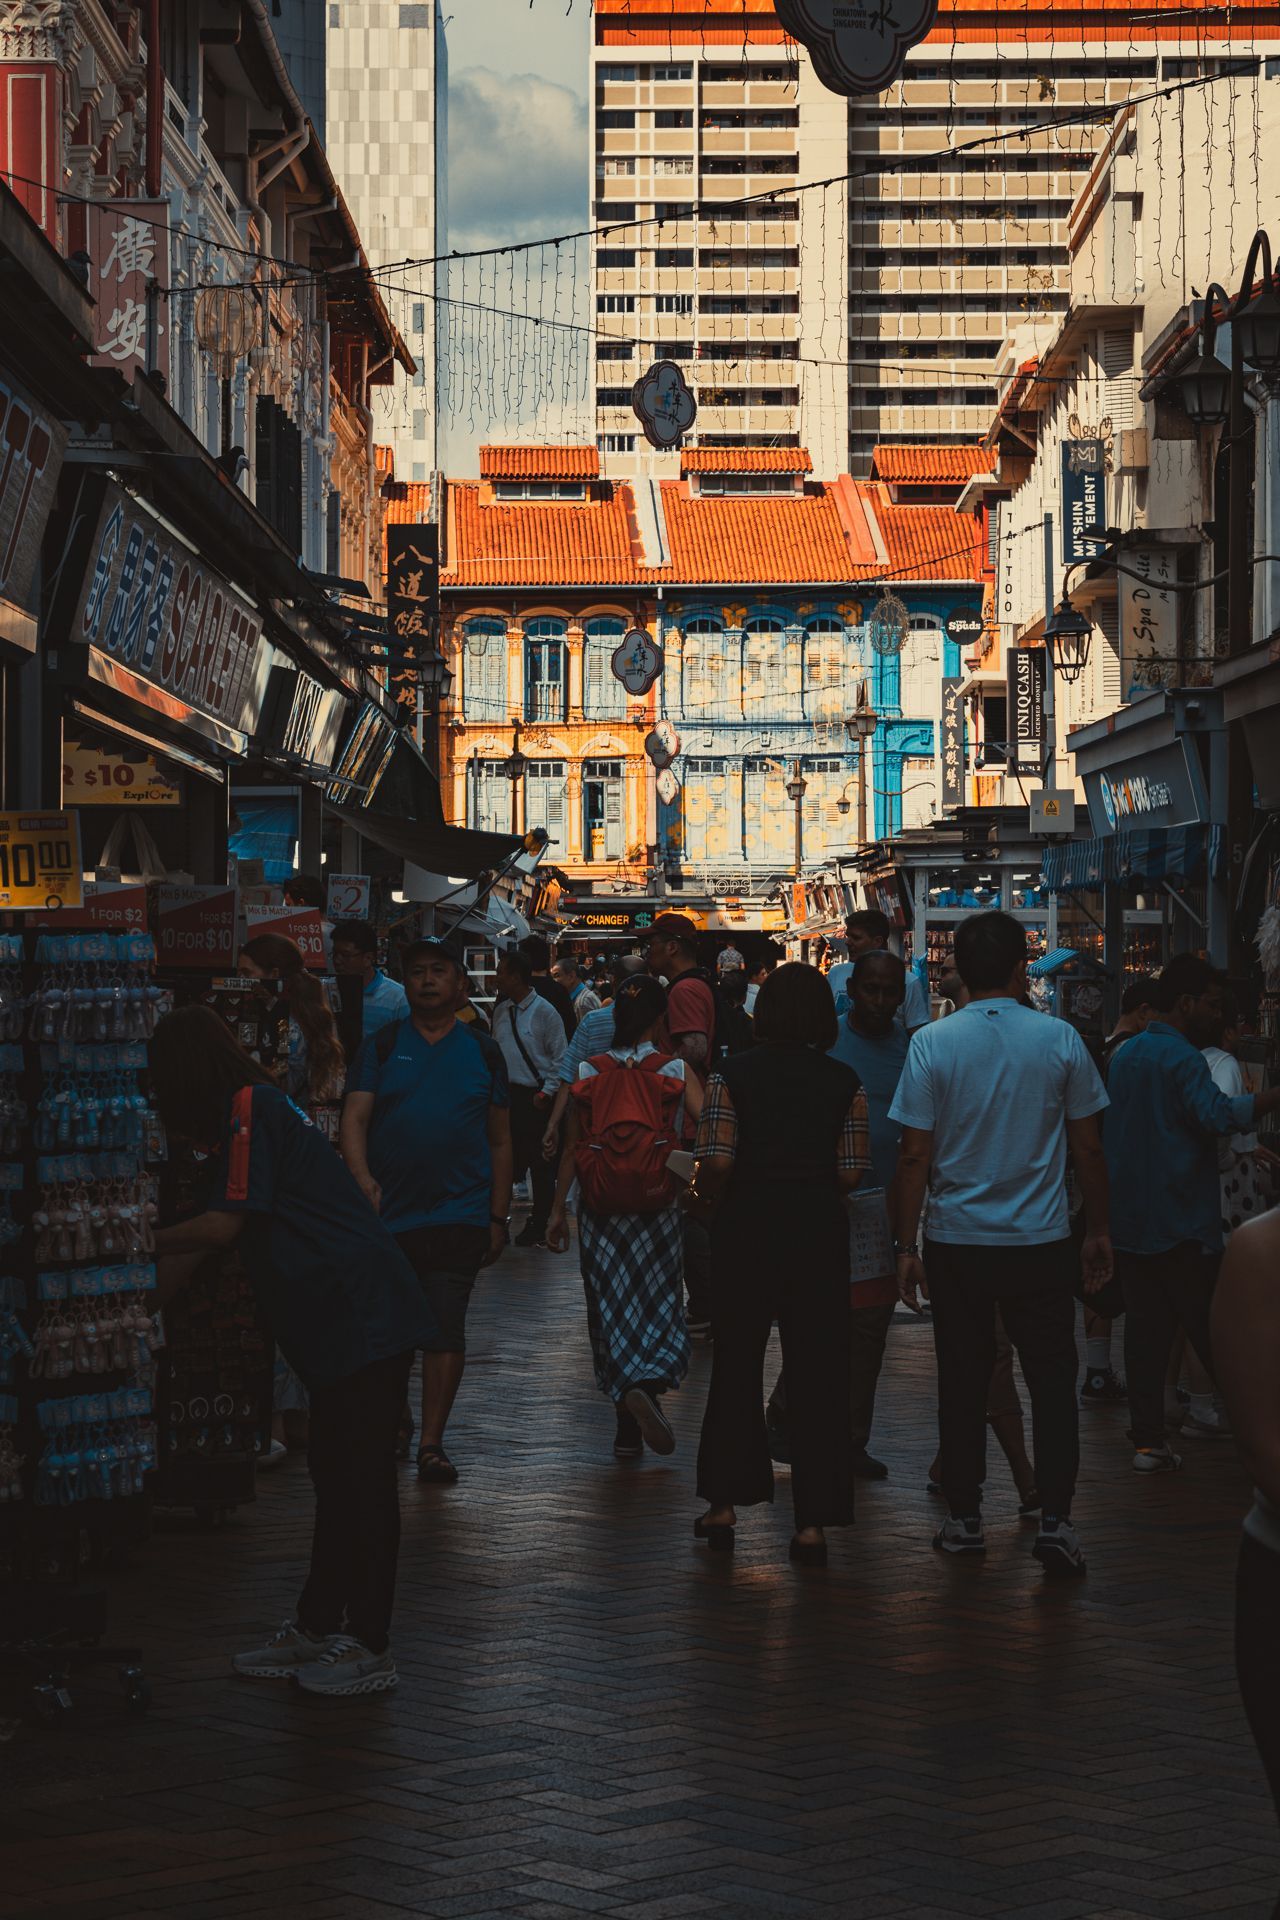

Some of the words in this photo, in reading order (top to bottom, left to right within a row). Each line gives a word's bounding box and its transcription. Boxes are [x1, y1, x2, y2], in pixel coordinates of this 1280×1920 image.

[832, 7, 867, 18] CHINATOWN
[832, 18, 867, 30] SINGAPORE
[1004, 512, 1014, 612] TATTOO
[104, 520, 175, 673] 思家客
[948, 620, 981, 632] Spuds
[1132, 607, 1159, 643] Spa
[160, 559, 260, 714] SCARLETT
[1017, 653, 1031, 738] UNIQCASH
[84, 764, 134, 786] $10
[1233, 843, 1243, 864] 5
[333, 886, 362, 912] $2
[90, 908, 96, 919] 1
[99, 911, 121, 920] FOR
[125, 908, 143, 922] $2
[204, 914, 219, 923] FOR
[221, 912, 232, 924] $2
[587, 915, 629, 925] CHANGER
[309, 924, 320, 934] $2
[161, 928, 174, 949] 10
[177, 933, 204, 949] FOR
[206, 928, 231, 952] $10
[298, 937, 322, 952] $10
